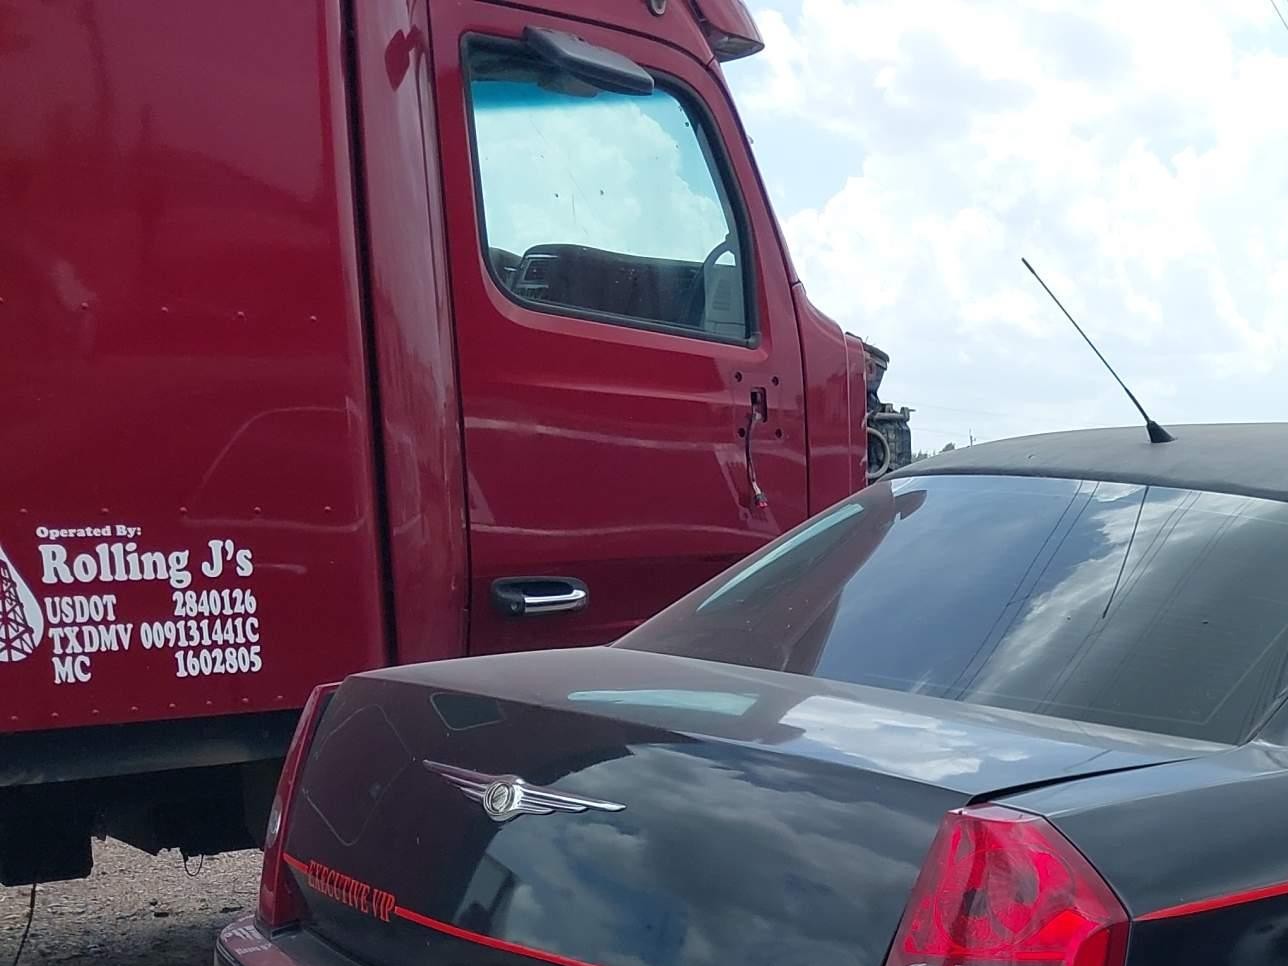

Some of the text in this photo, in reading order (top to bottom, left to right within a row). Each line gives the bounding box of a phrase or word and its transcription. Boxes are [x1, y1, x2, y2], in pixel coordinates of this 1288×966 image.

[36, 525, 142, 540] Operated By:
[38, 539, 254, 588] Rolling J's
[44, 589, 257, 624] USDOT 2840126
[49, 617, 260, 654] TXDMV 009131441C
[52, 646, 262, 684] MC 1602805
[308, 859, 395, 922] EXECUTIVE VIP
